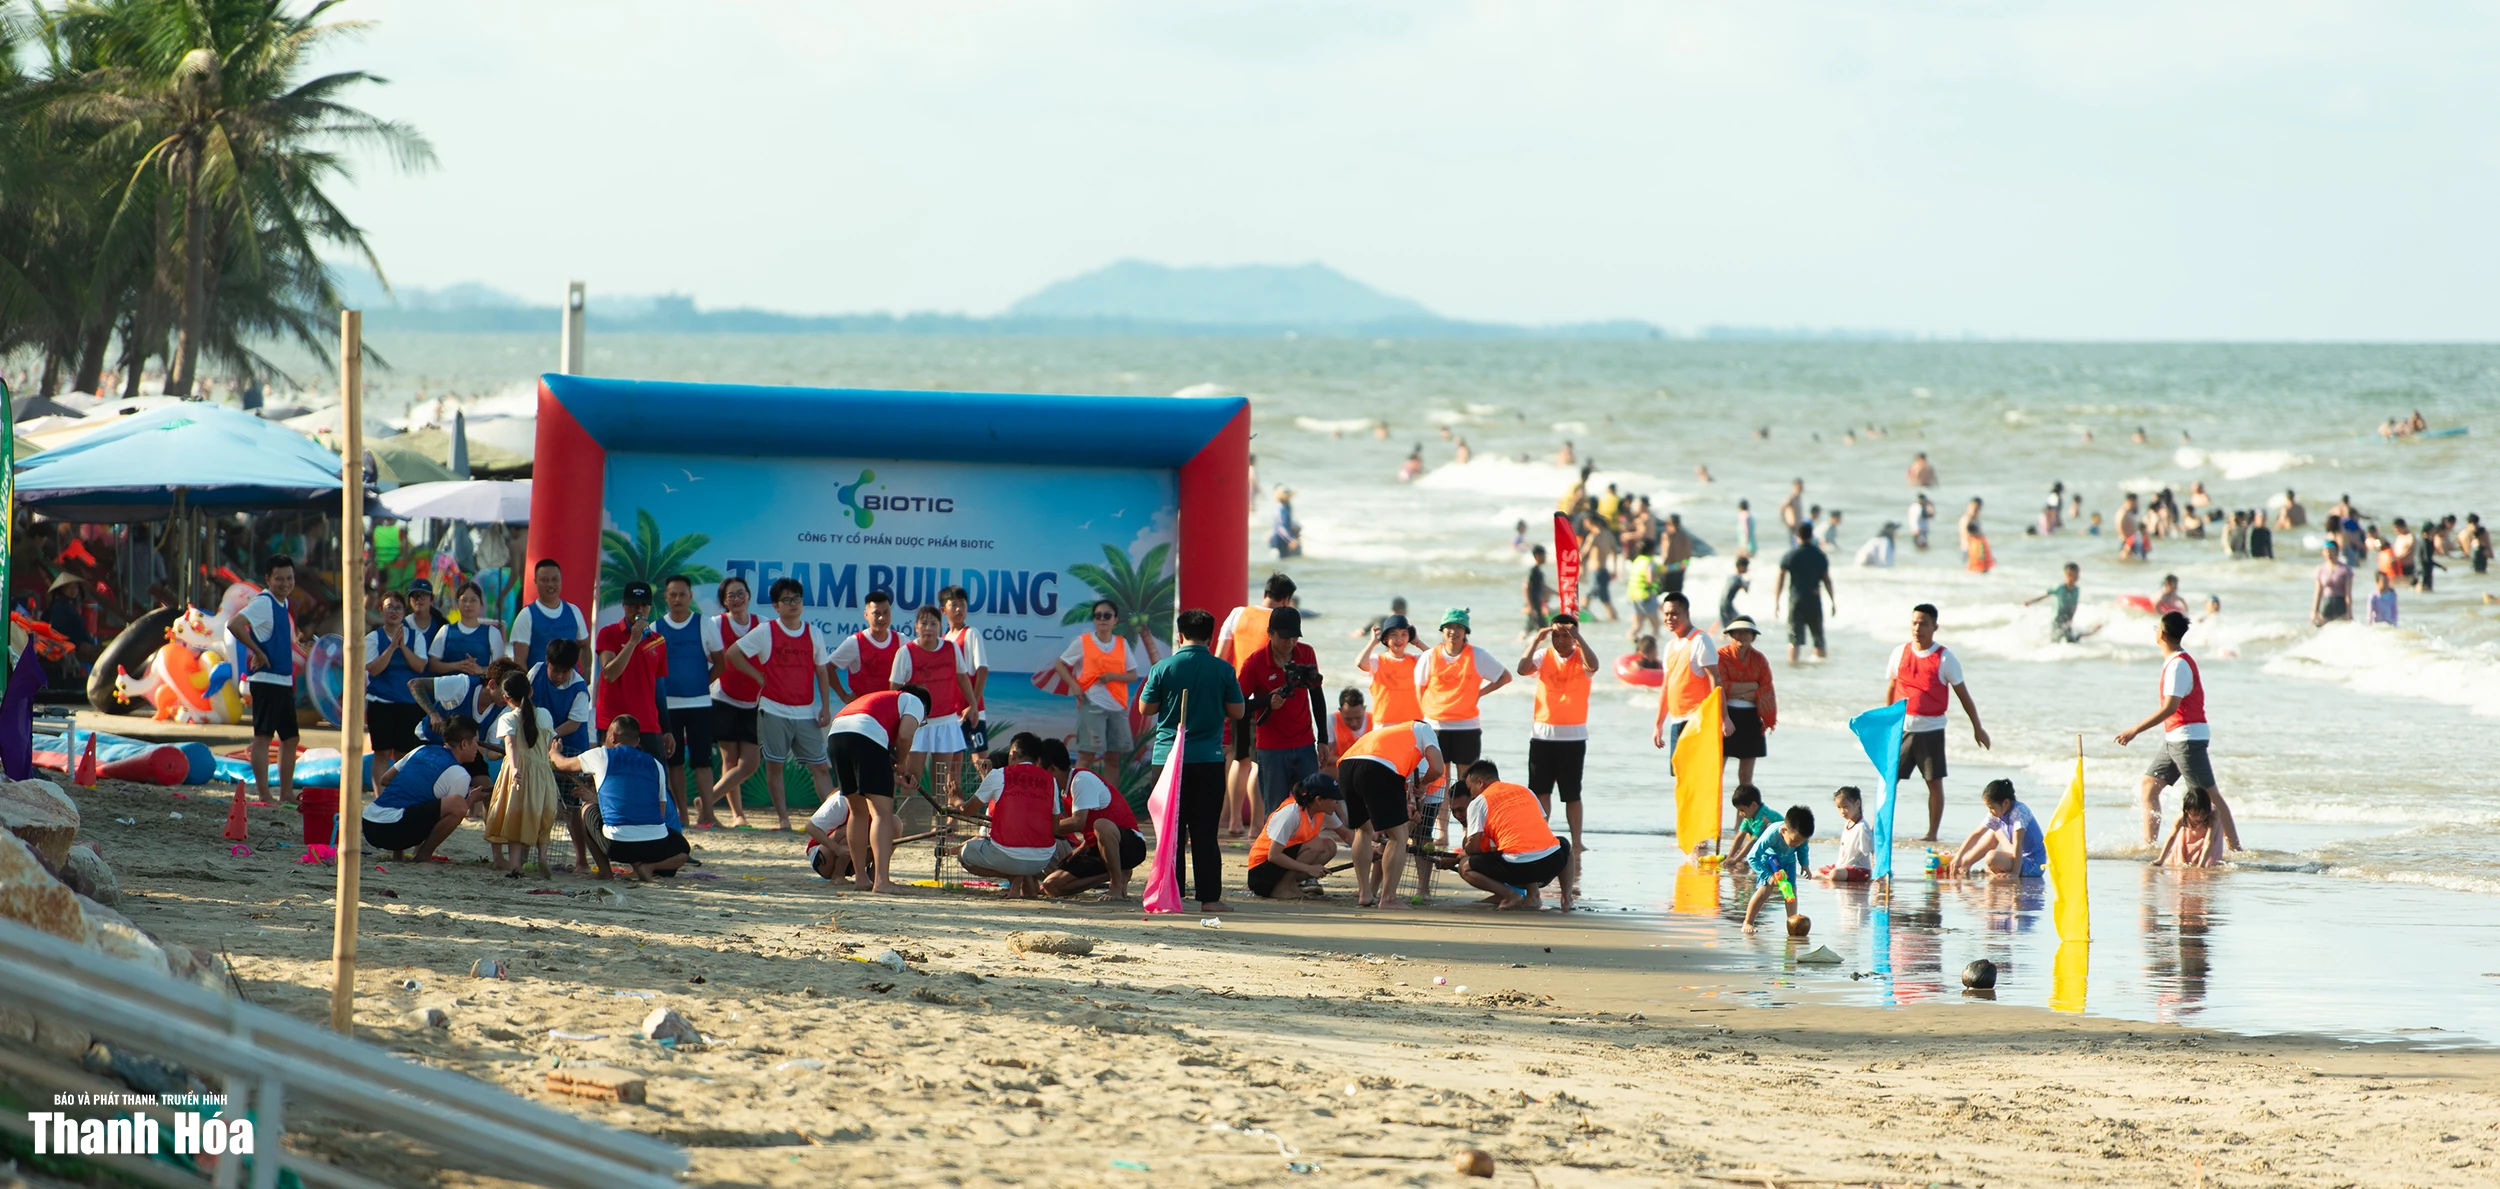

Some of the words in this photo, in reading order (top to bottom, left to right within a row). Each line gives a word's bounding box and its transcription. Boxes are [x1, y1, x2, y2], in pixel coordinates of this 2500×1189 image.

[863, 495, 954, 513] BIOTIC
[798, 531, 827, 543] CÔNG
[830, 533, 843, 543] TY
[846, 531, 861, 544] CỔ
[895, 536, 925, 548] DƯỢC
[927, 534, 958, 548] PHẨM
[960, 539, 995, 549] BIOTIC
[726, 559, 858, 608] TEAM
[868, 564, 1059, 617] BUILDING
[982, 626, 1028, 641] CÔNG
